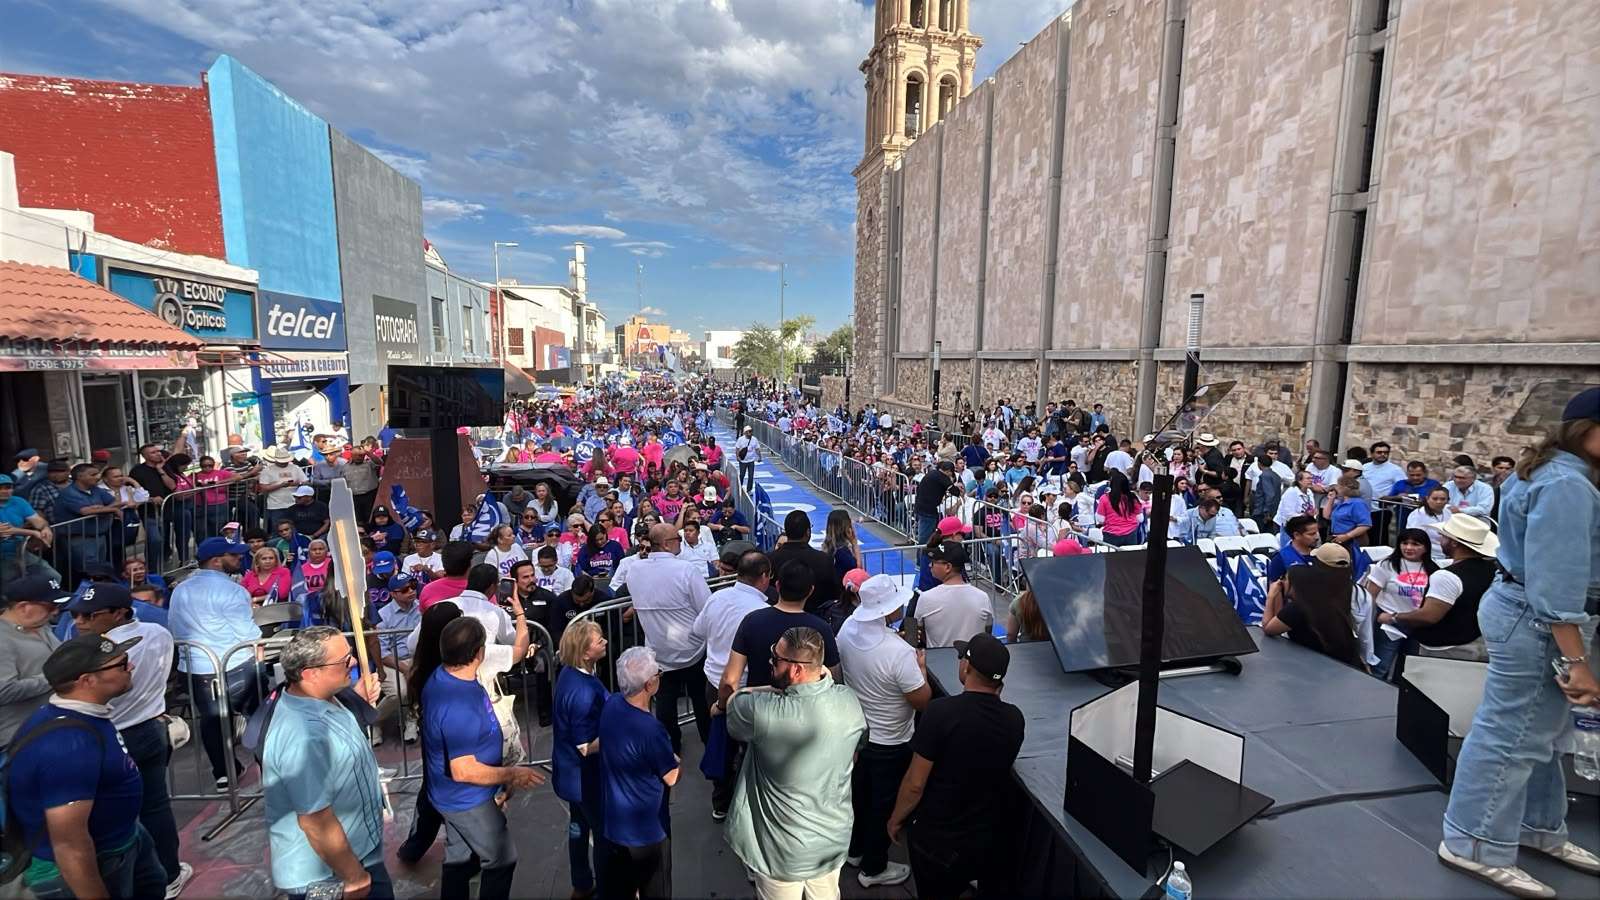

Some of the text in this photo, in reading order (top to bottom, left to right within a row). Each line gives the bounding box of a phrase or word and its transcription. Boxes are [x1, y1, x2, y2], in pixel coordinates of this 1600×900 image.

[186, 305, 226, 329] Ópticas
[267, 304, 337, 339] telcel
[375, 313, 419, 344] FOTOGRAFÍA
[28, 360, 84, 370] DESDE 1975
[311, 360, 317, 372] A
